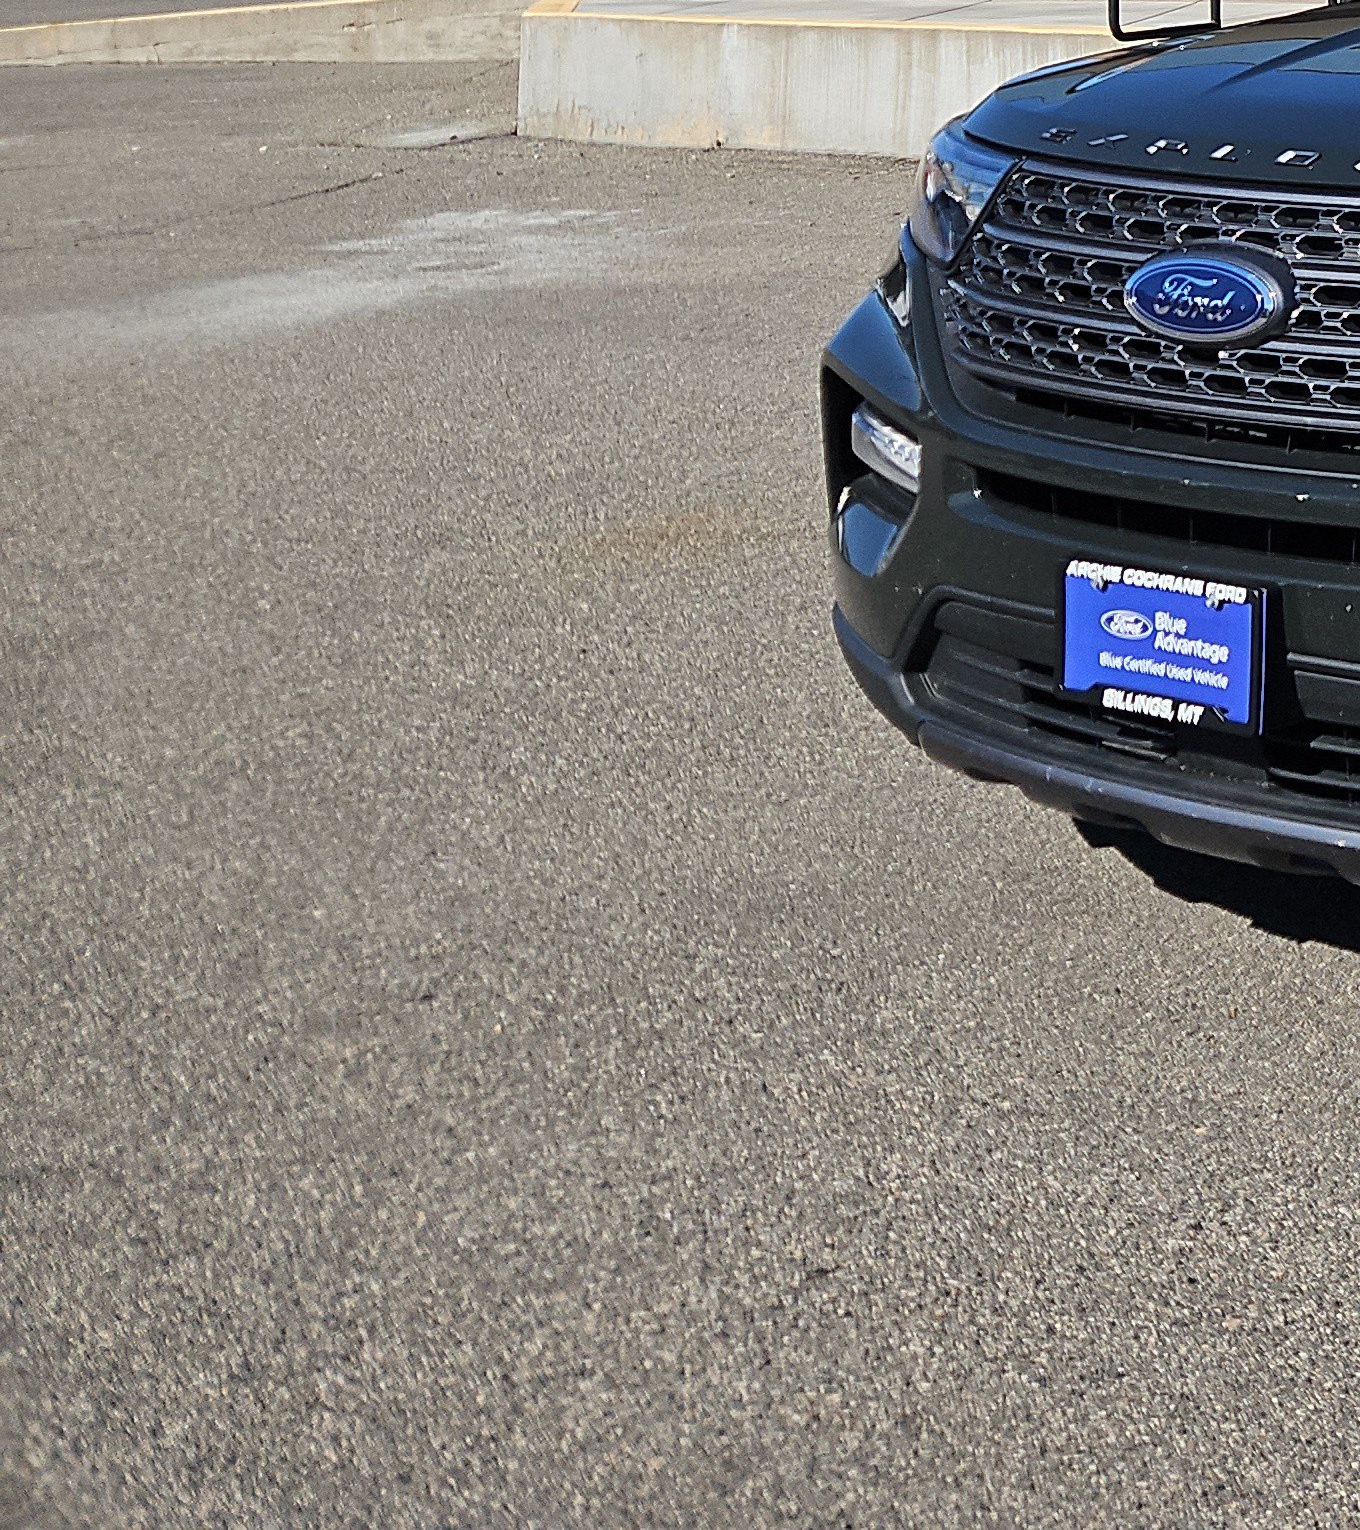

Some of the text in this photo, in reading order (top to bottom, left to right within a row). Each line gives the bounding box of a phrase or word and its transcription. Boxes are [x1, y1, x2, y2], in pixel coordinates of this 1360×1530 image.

[1153, 274, 1235, 321] Ford
[1066, 560, 1247, 605] ARCHIE COCHRANE FORD
[1154, 611, 1187, 635] Blue
[1099, 651, 1123, 669] Blue
[1154, 633, 1229, 664] Advantage
[1102, 688, 1204, 725] BILLINGS, MT
